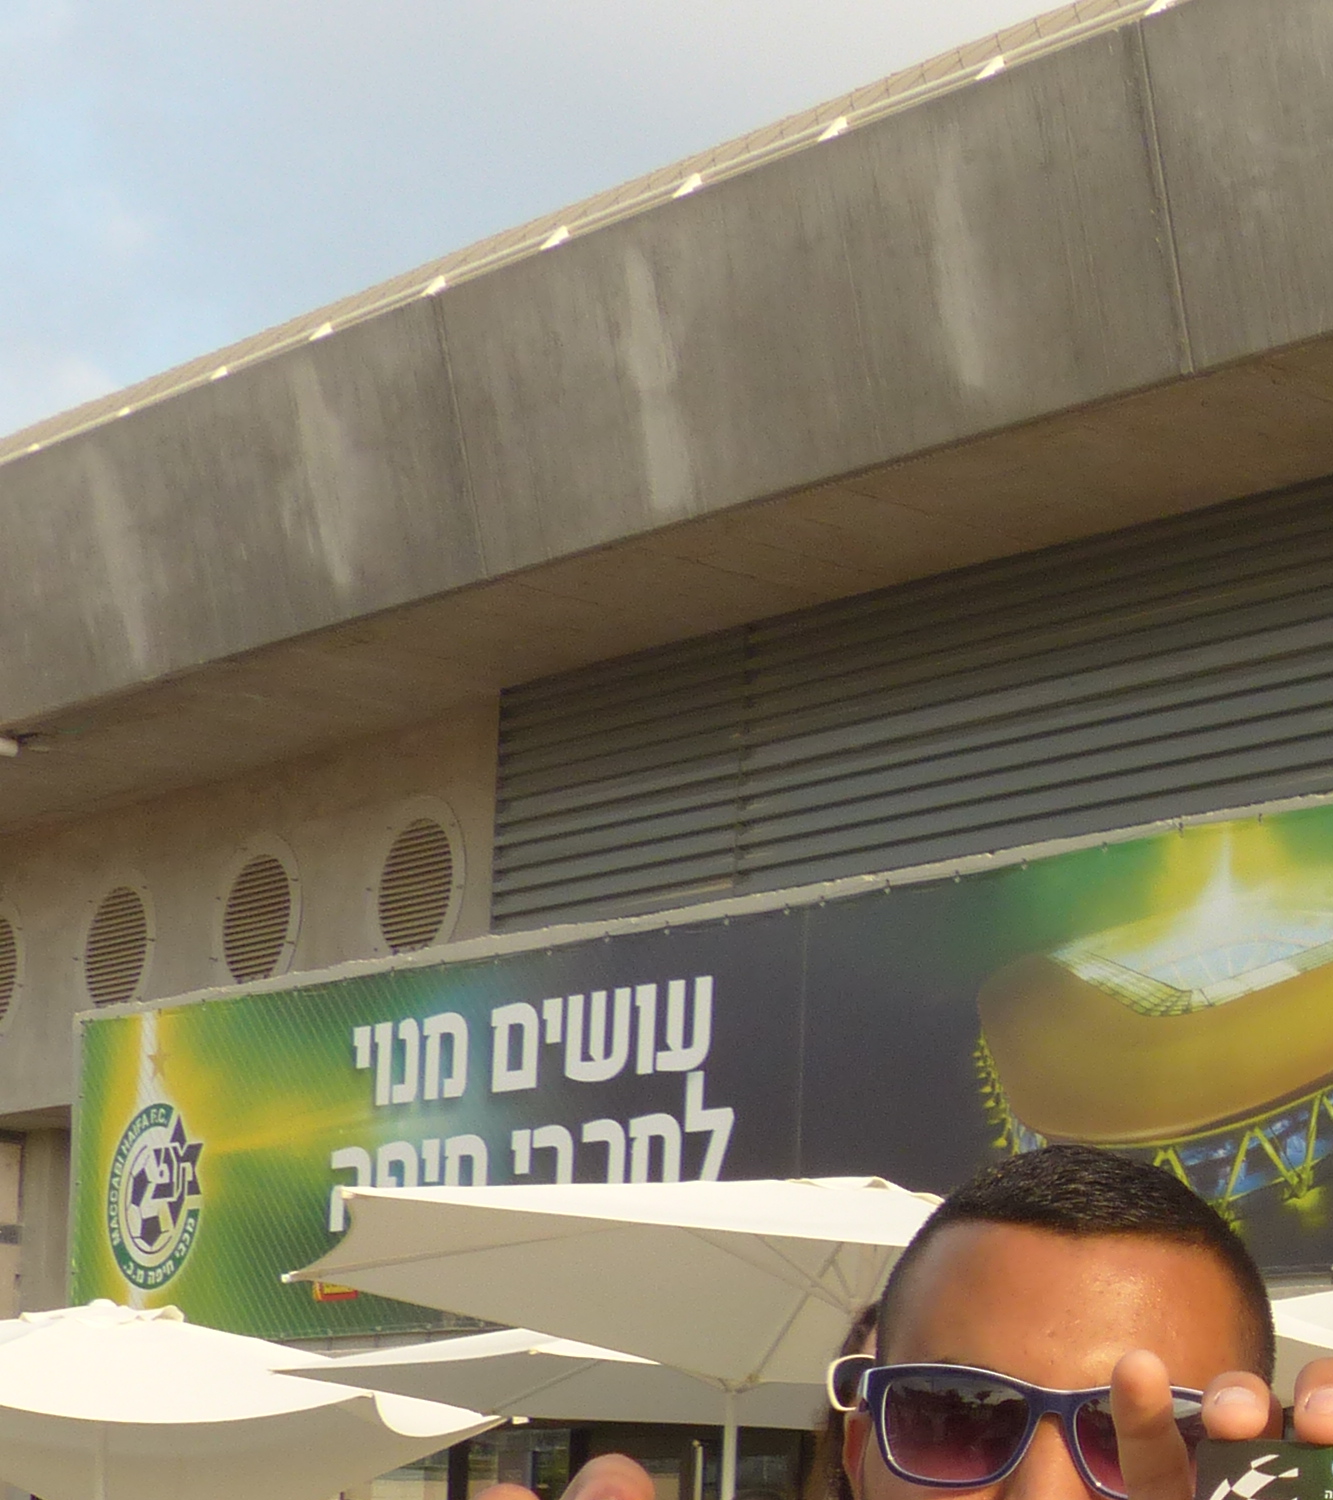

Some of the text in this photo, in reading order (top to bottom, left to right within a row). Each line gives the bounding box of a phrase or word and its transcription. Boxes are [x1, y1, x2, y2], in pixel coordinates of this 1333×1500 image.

[353, 975, 714, 1107] עושים מנוי
[109, 1158, 125, 1246] MACCABI
[121, 1112, 150, 1154] HAIFA
[147, 1262, 175, 1285] חיפה
